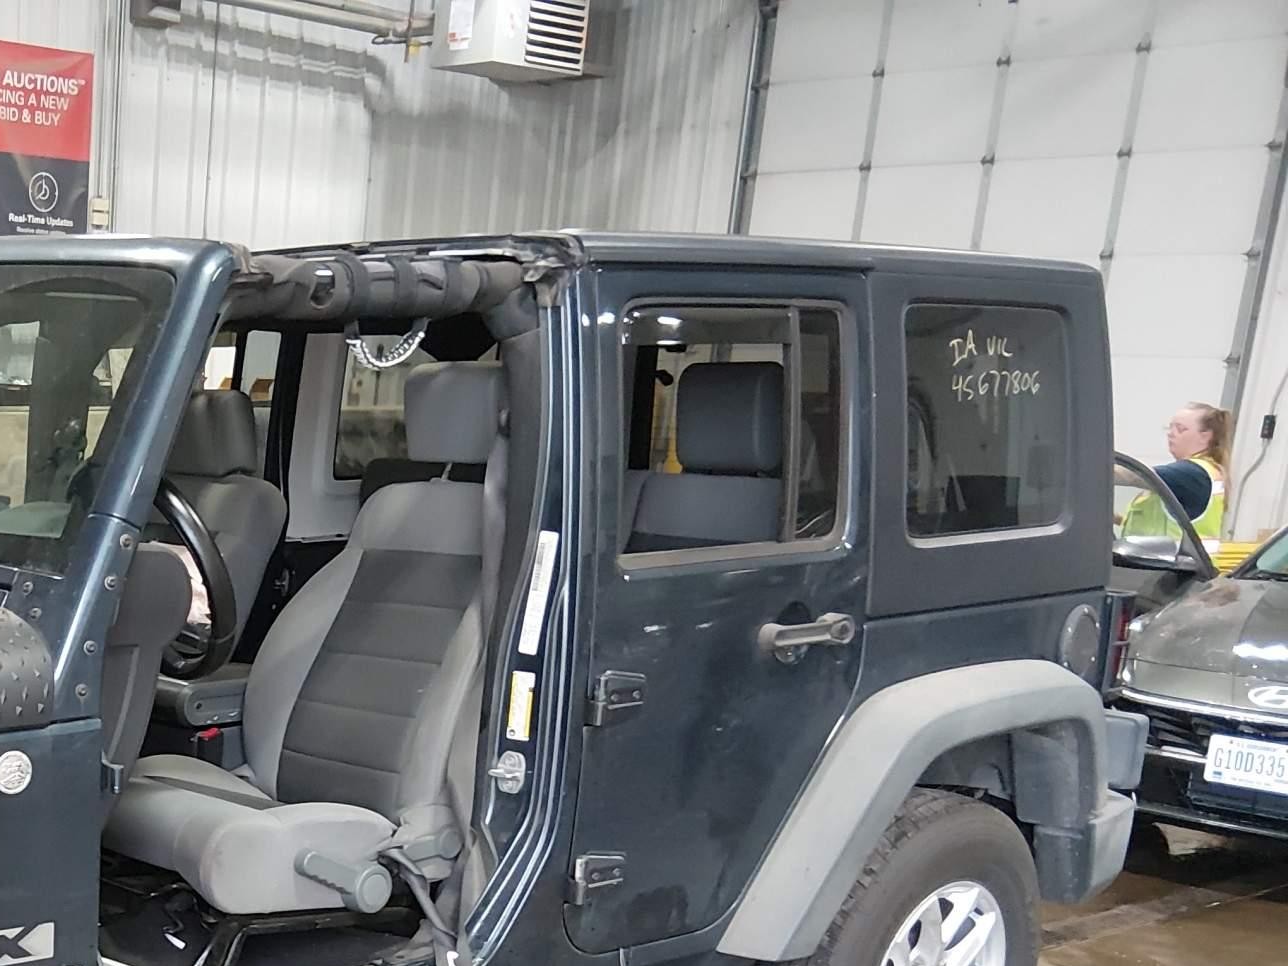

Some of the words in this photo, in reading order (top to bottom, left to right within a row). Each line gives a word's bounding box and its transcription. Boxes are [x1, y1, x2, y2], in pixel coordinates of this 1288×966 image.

[27, 93, 37, 107] A
[40, 95, 69, 111] NEW
[0, 106, 19, 122] BID
[22, 109, 31, 124] &
[35, 110, 61, 127] BUY
